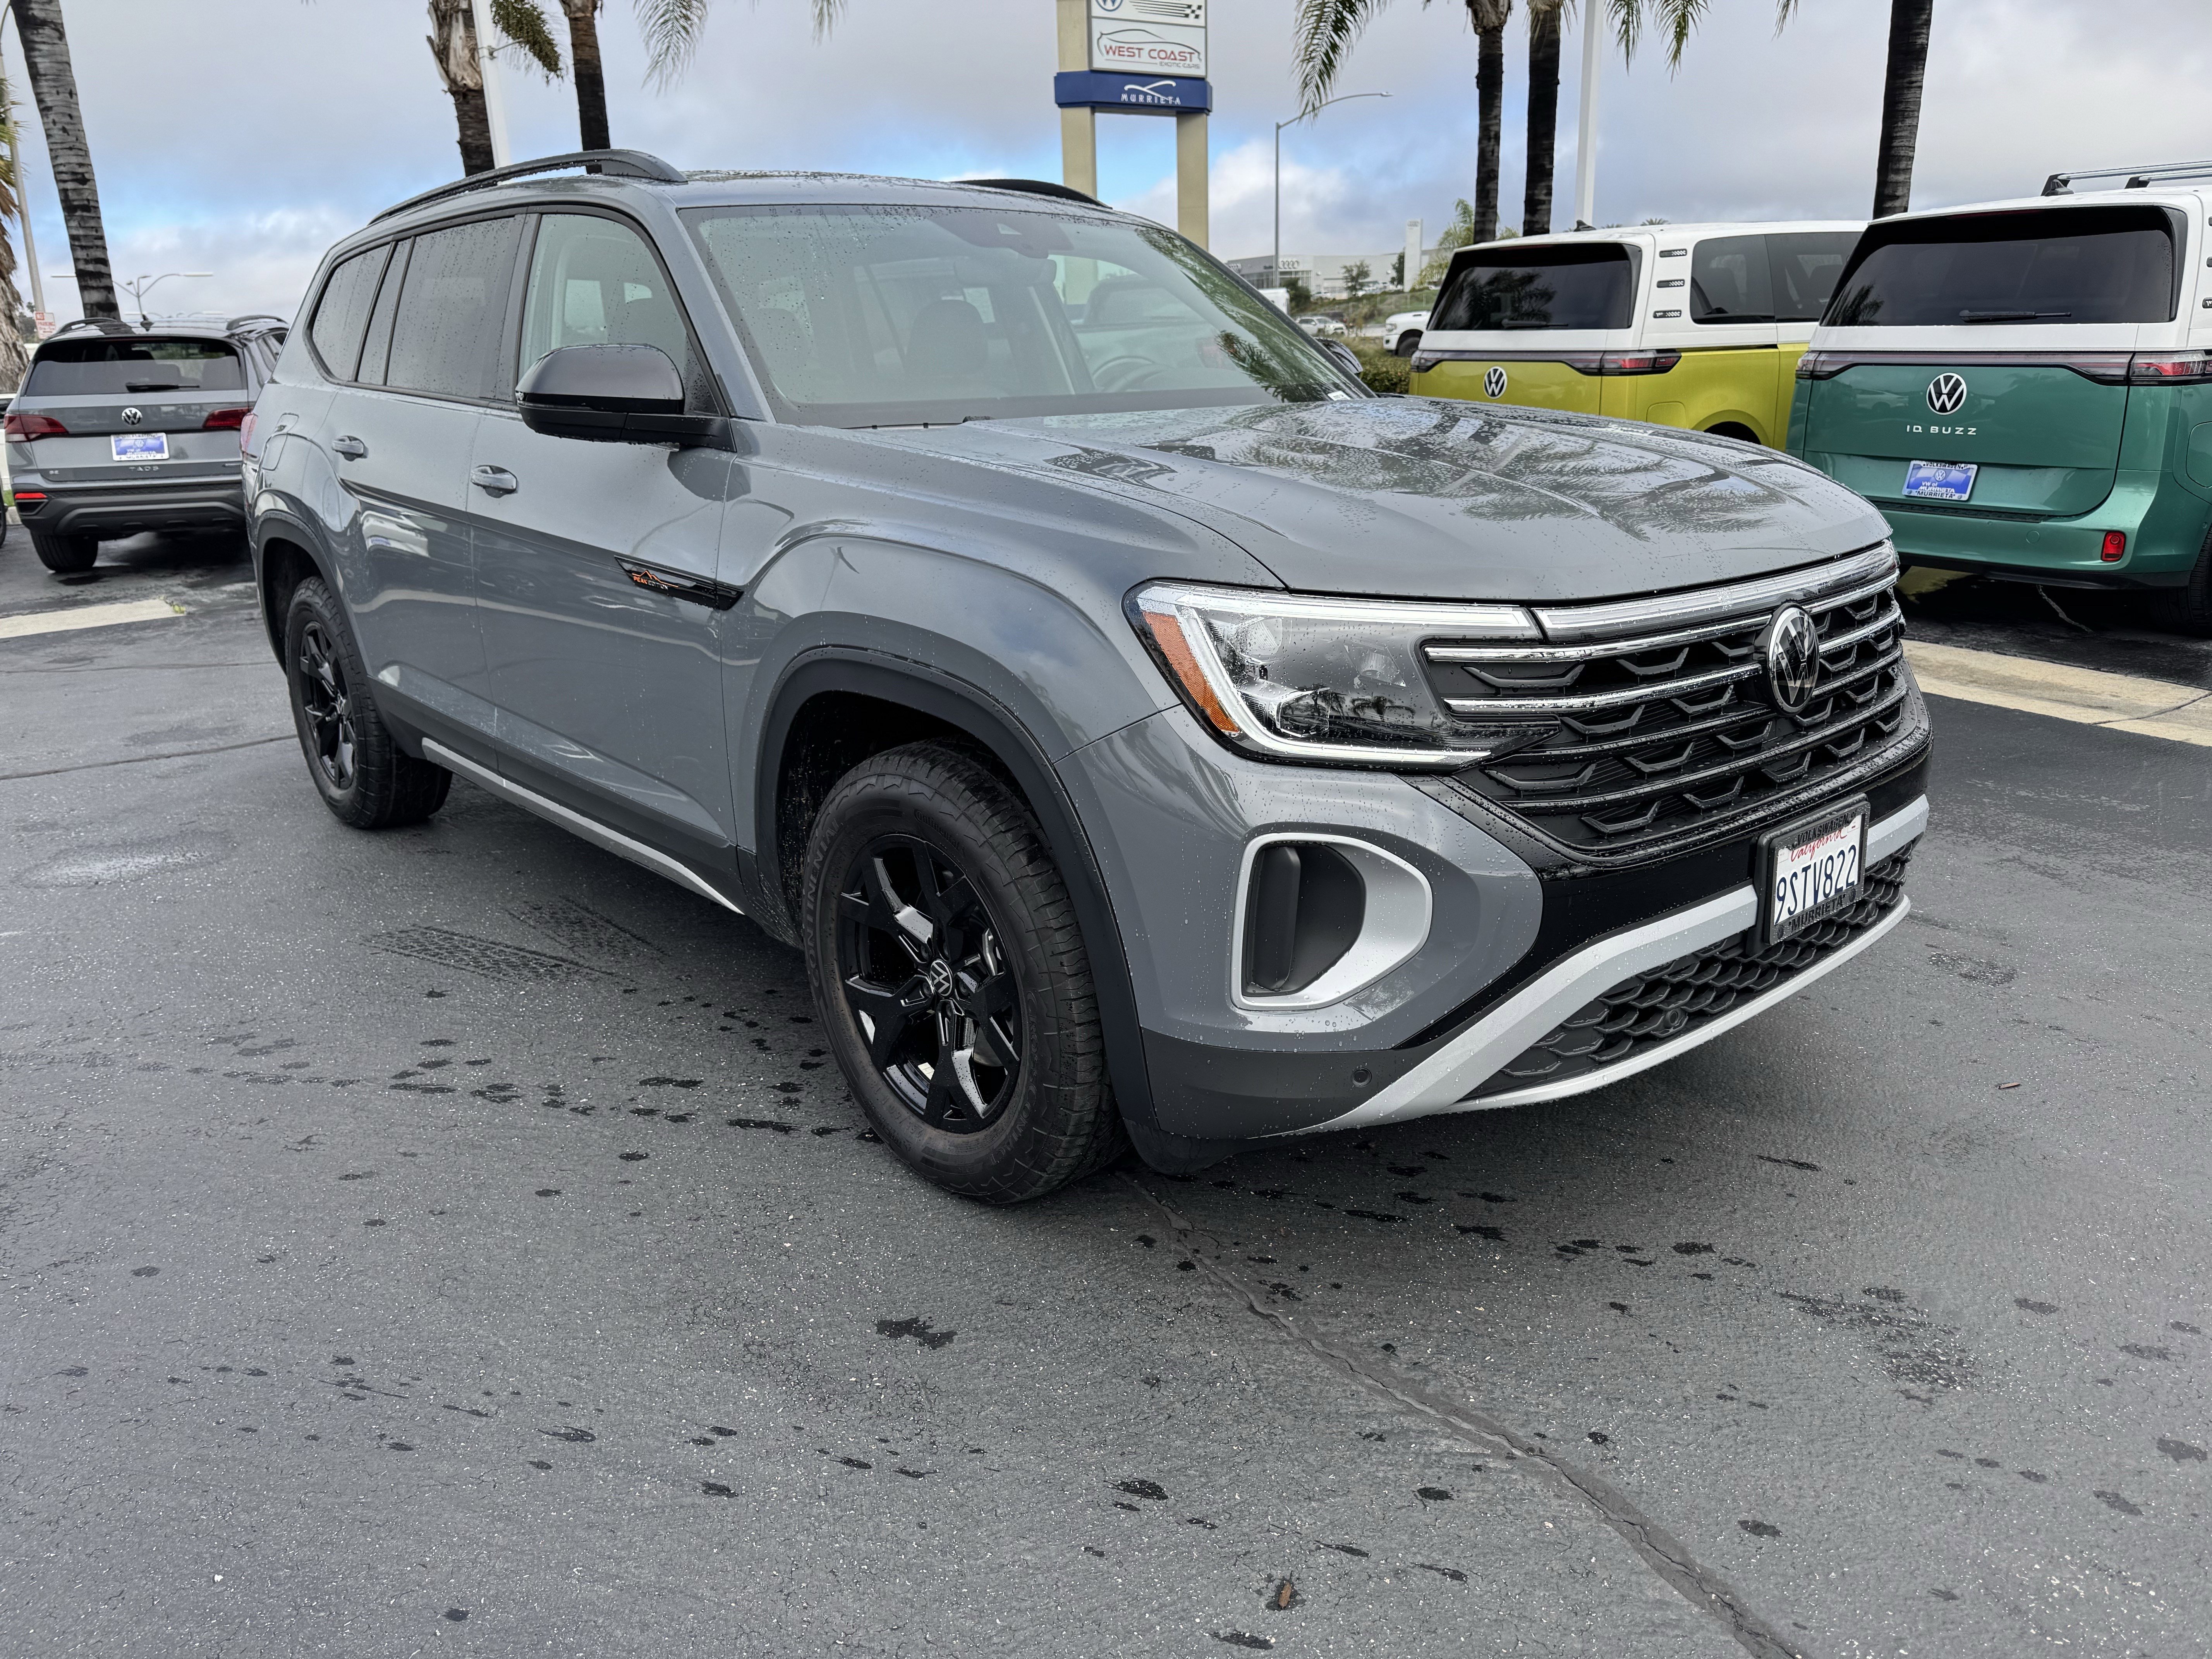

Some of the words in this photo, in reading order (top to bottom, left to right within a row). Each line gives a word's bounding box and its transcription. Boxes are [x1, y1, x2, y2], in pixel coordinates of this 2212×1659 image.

[1104, 44, 1144, 58] WEST
[1148, 49, 1195, 62] COAST
[1121, 93, 1181, 105] MURRIETA
[1930, 426, 1977, 435] BUZZ
[1917, 490, 1954, 498] MURRIETA
[633, 576, 647, 584] PEAK
[1797, 812, 1849, 846] VOLKSWAGEN
[1791, 828, 1847, 862] California
[1774, 845, 1856, 925] 9STV822
[807, 817, 843, 988] CONTINENTAL
[1791, 895, 1843, 931] MURRIETA
